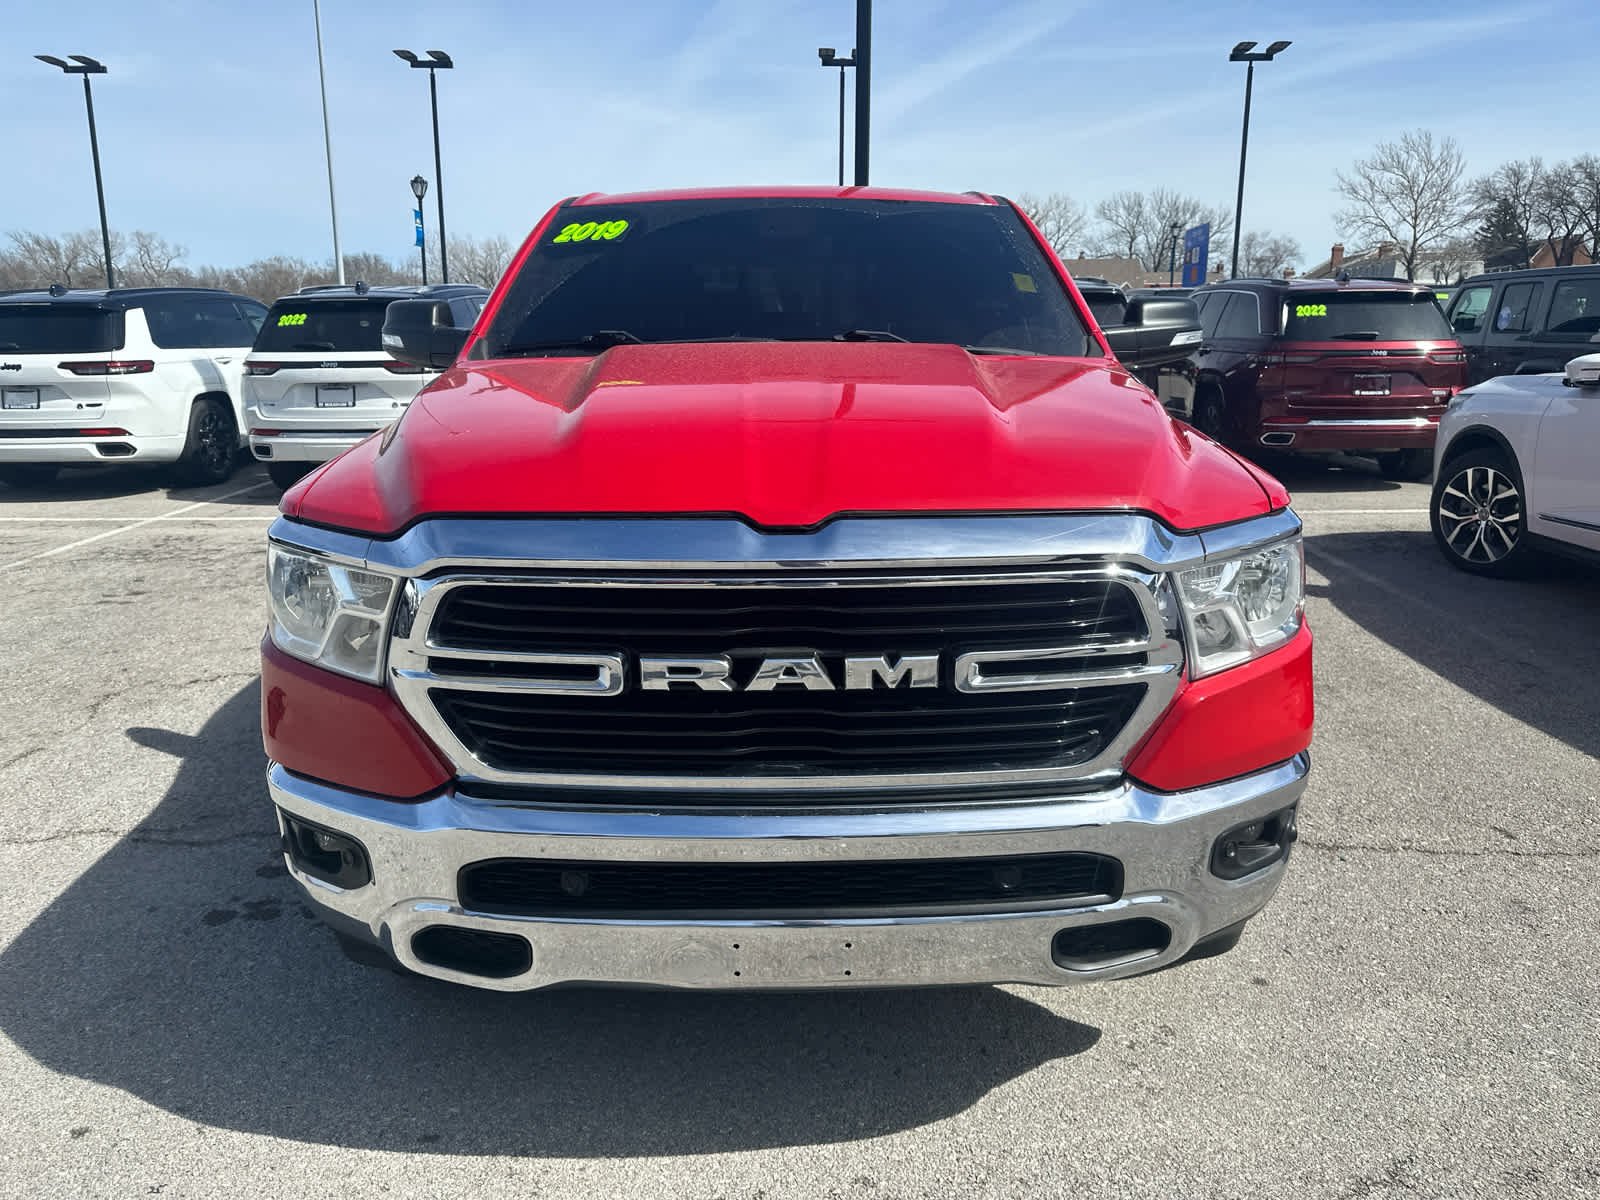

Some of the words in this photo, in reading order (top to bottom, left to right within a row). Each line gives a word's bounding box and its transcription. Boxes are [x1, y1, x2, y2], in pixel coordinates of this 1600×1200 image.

[553, 220, 629, 243] 2019
[1296, 304, 1327, 317] 2022
[278, 313, 307, 326] 2022
[0, 362, 22, 371] Jeep
[640, 653, 939, 691] RAM
